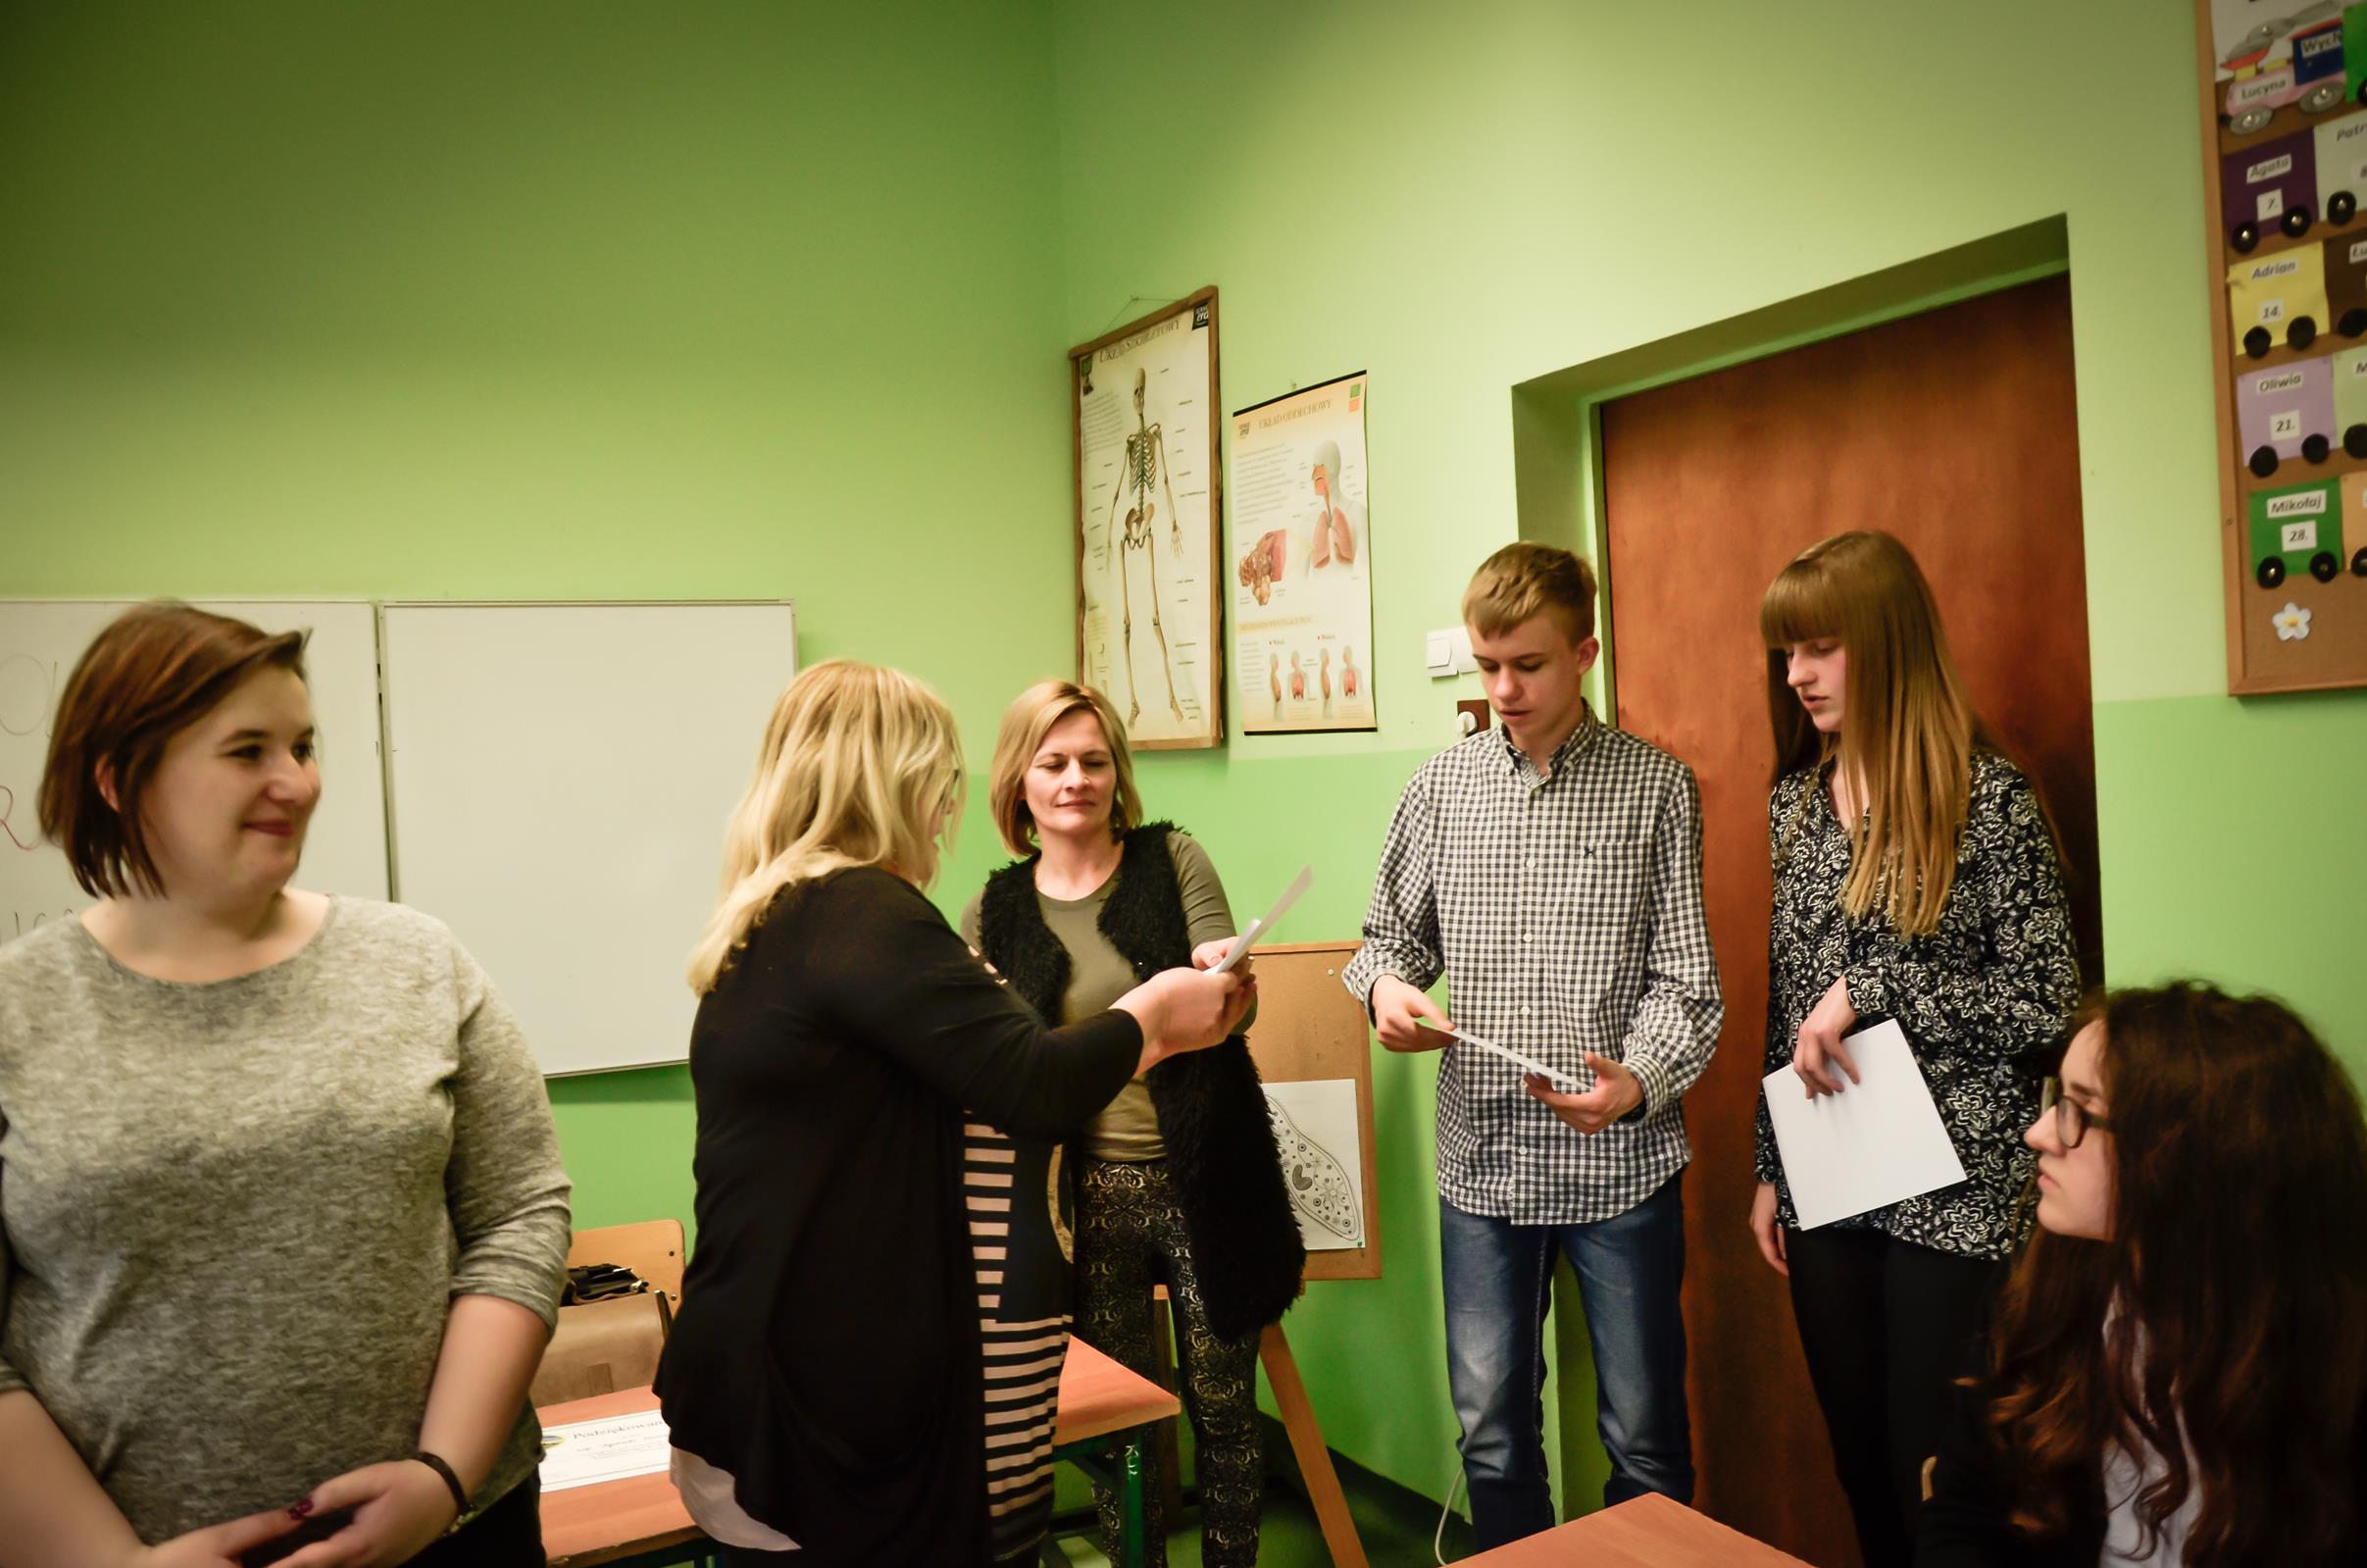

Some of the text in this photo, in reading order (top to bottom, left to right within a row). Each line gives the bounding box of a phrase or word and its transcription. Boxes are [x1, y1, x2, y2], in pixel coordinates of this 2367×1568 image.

[2241, 79, 2287, 99] Lucyna
[2248, 158, 2290, 177] Agata
[2251, 262, 2296, 280] Adrian
[2259, 374, 2301, 392] Oliwia
[2271, 494, 2323, 513] Mikołaj
